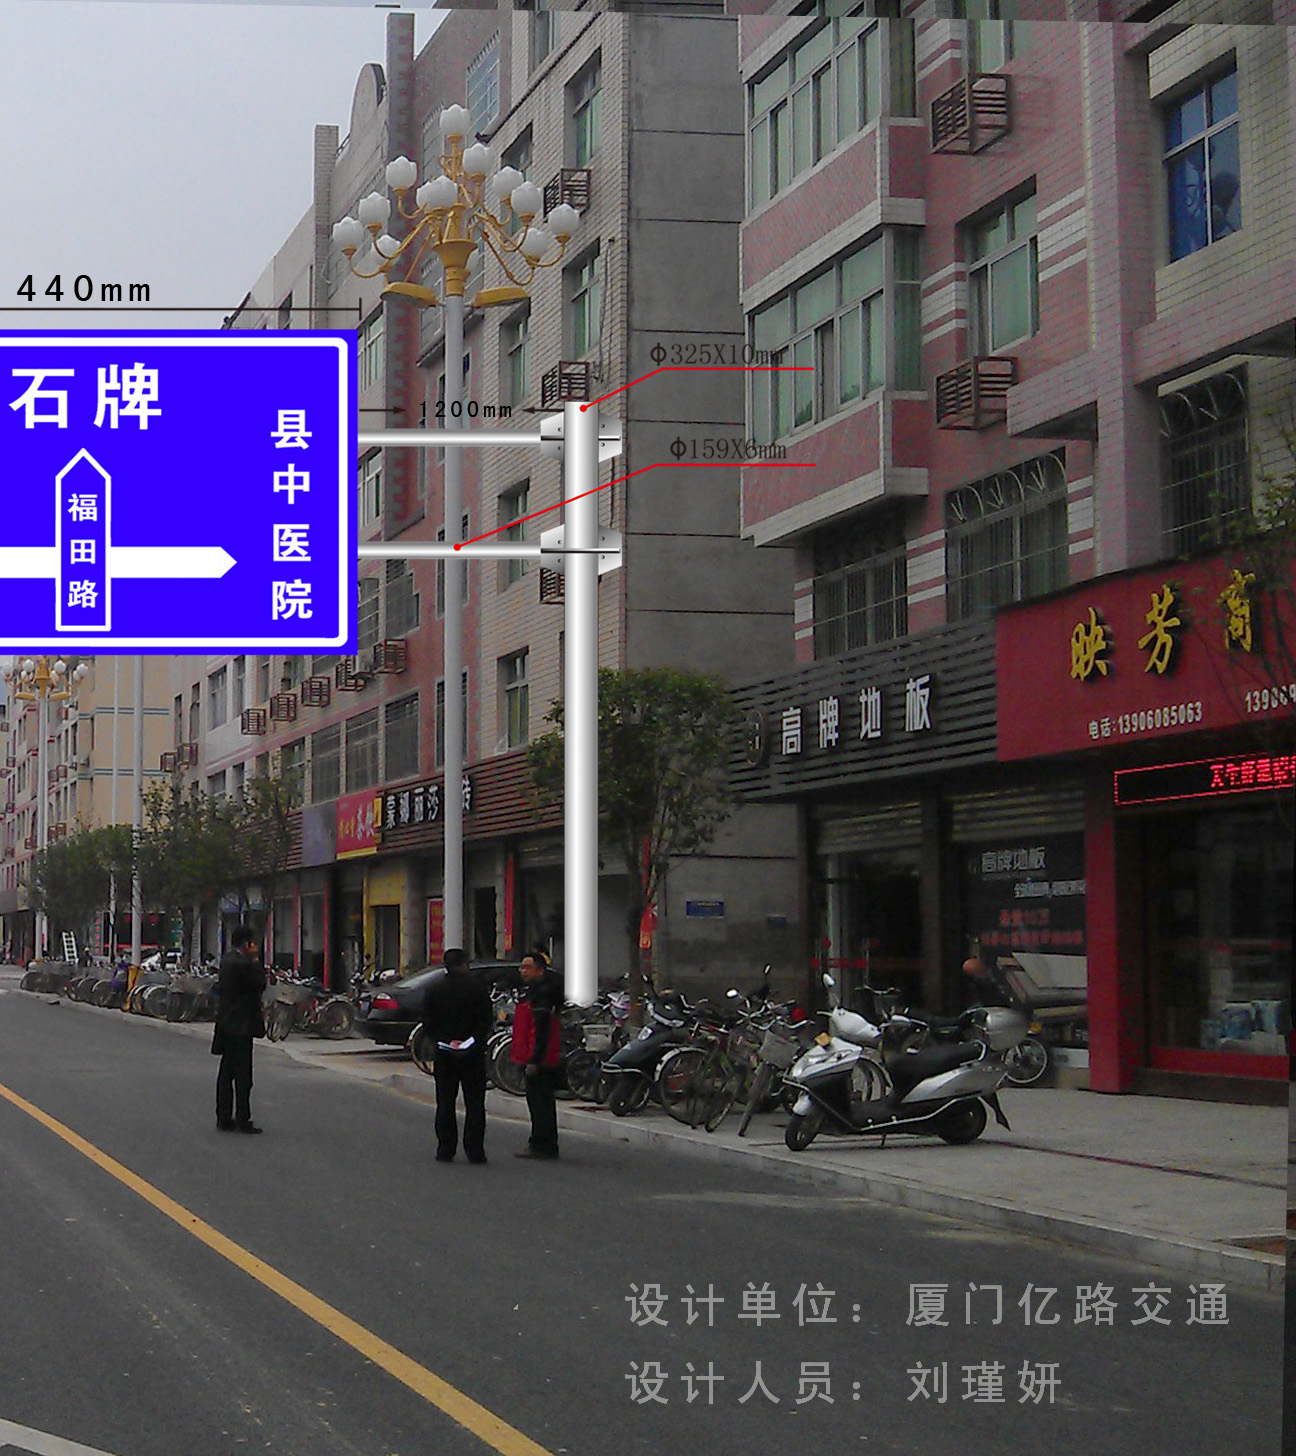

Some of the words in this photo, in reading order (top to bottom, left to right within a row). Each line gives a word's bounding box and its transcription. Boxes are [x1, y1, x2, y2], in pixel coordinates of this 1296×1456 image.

[9, 363, 162, 430] 石牌
[67, 493, 99, 609] 福田路
[270, 409, 313, 620] 县中医院
[782, 674, 932, 756] 高牌地板
